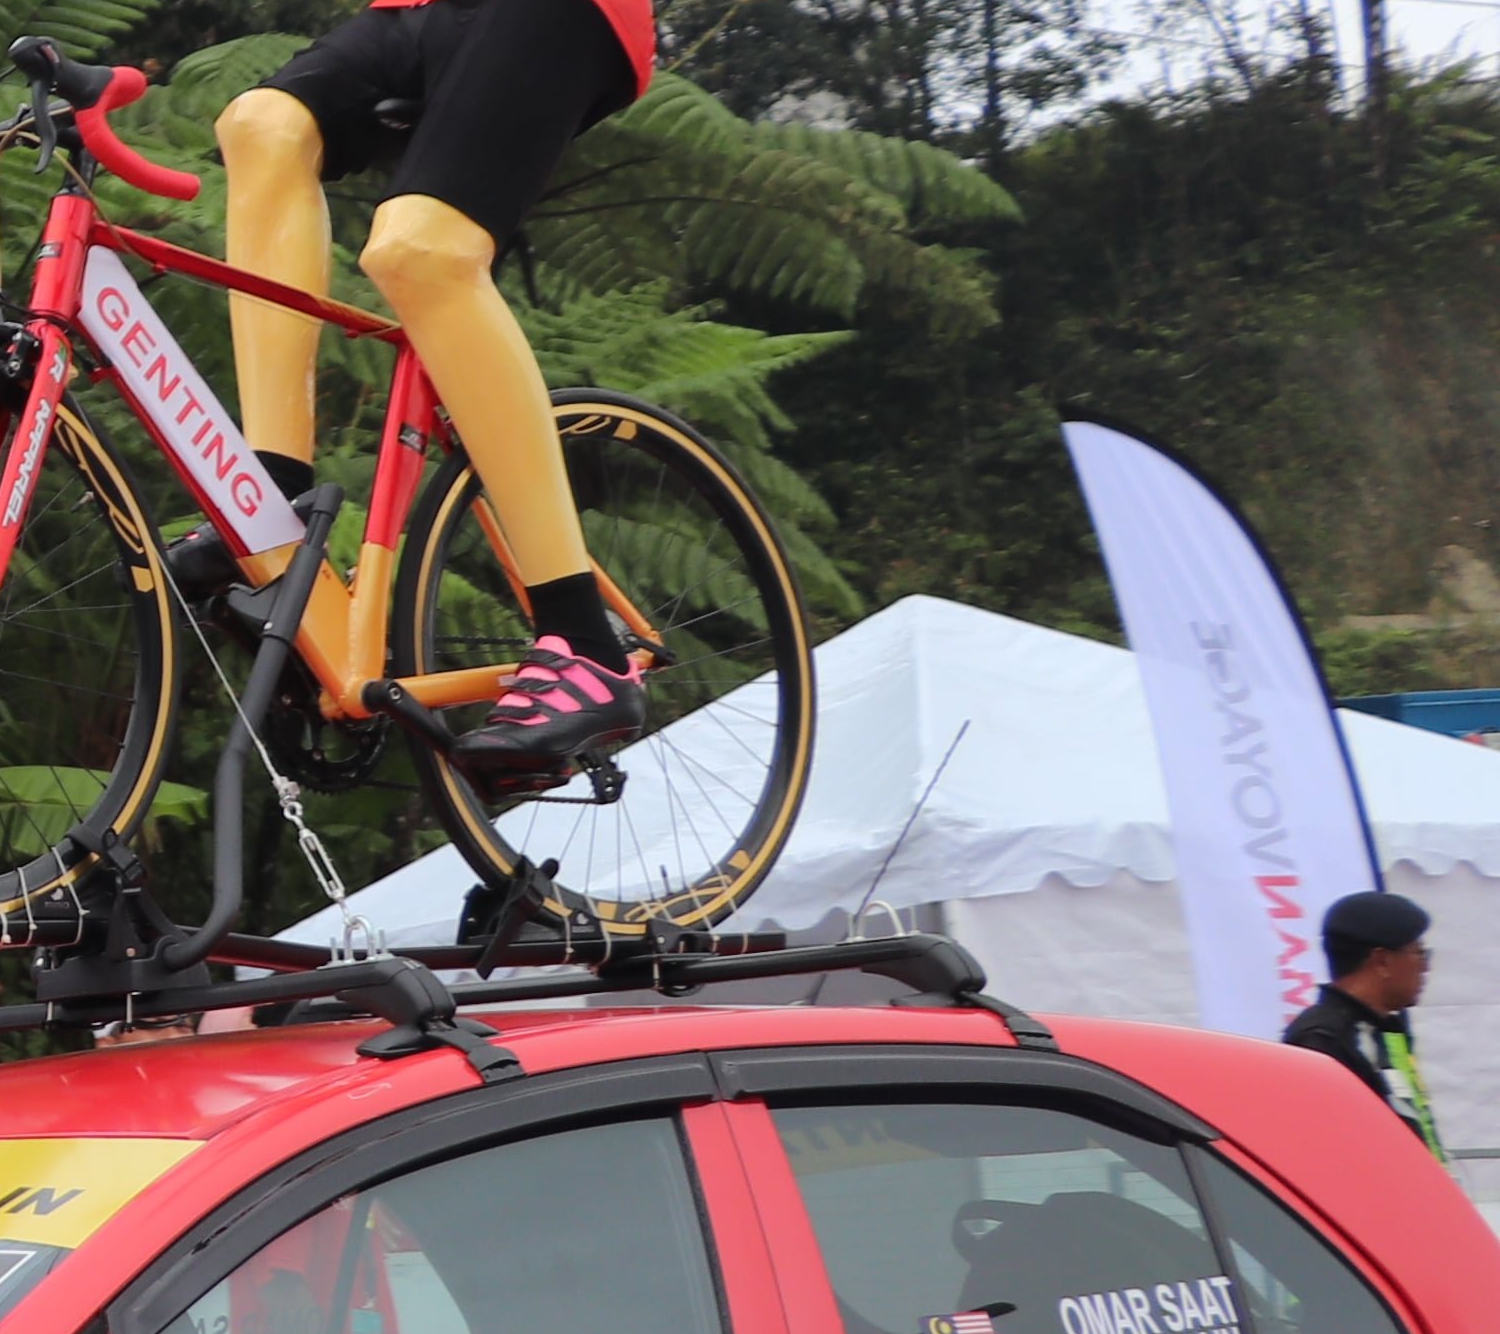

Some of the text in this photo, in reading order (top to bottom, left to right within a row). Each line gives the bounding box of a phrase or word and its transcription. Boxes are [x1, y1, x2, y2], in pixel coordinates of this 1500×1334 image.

[2, 398, 51, 529] APPAREL
[96, 286, 264, 518] GENTING
[1155, 1275, 1239, 1332] SAAT
